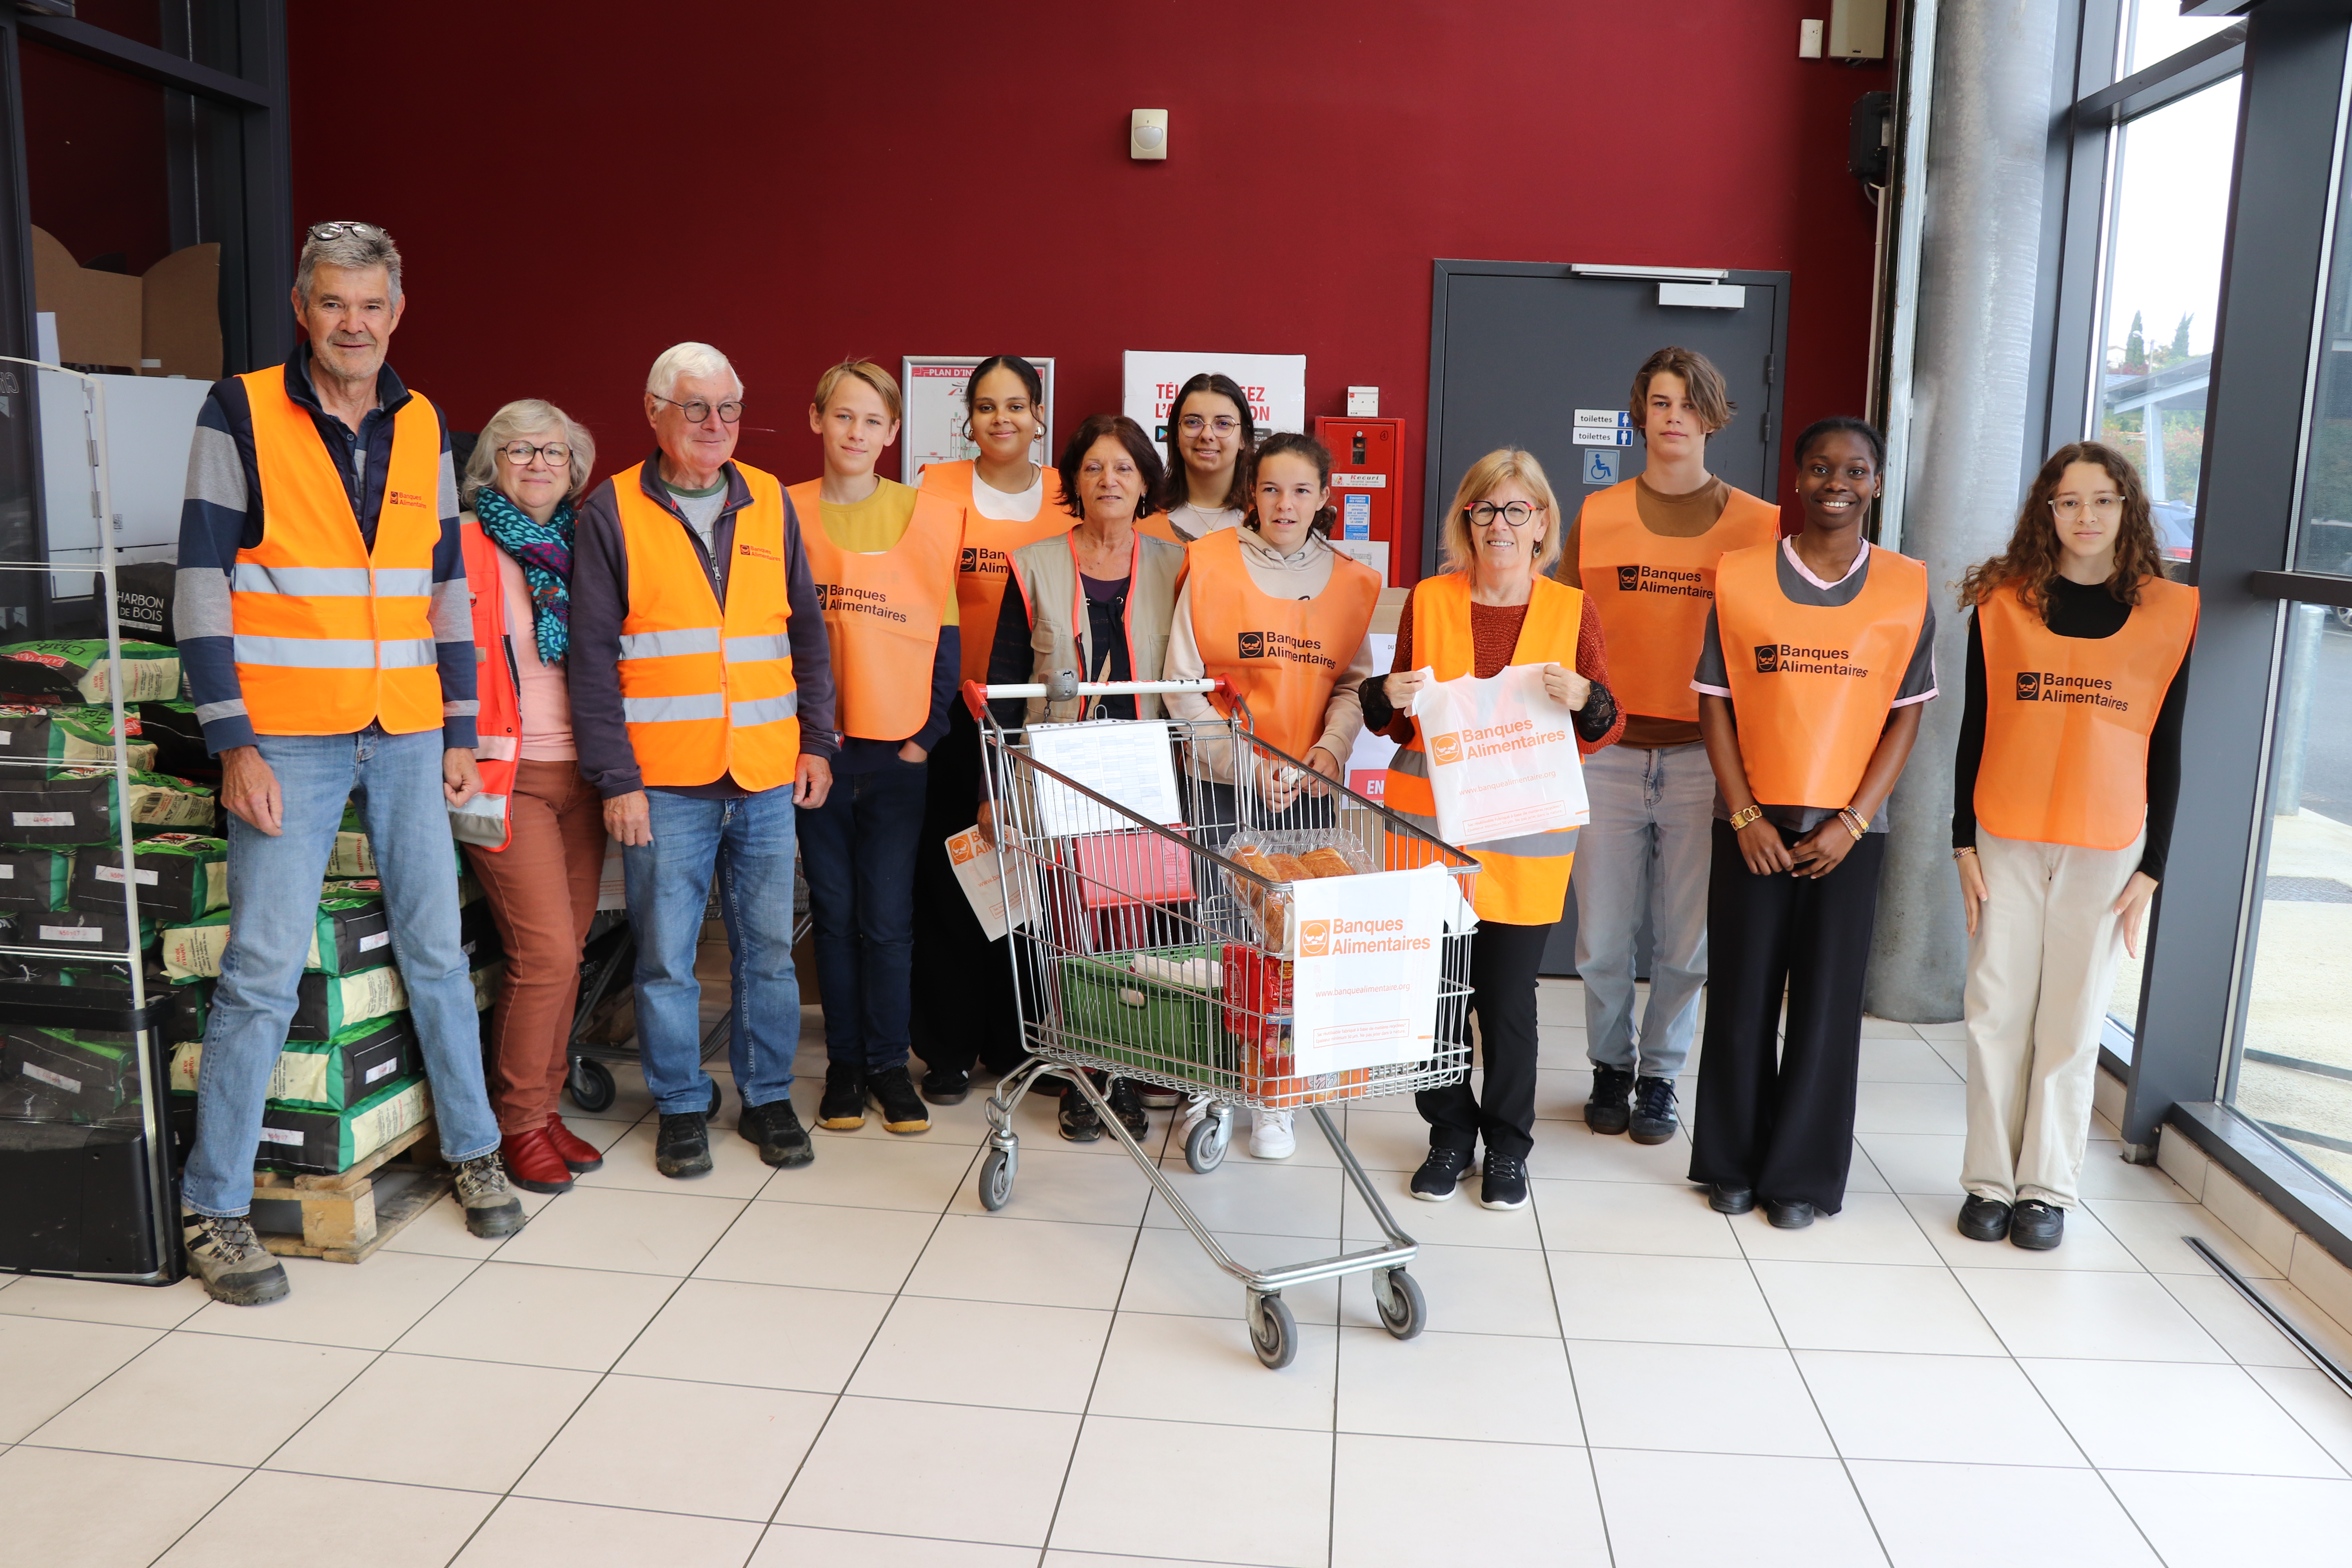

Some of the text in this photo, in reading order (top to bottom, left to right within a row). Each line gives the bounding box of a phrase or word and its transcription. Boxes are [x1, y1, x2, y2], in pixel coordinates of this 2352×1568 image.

[1581, 415, 1612, 423] toilettes
[1579, 432, 1611, 441] toilettes
[399, 492, 421, 501] Banques
[399, 500, 426, 509] Alimentaires
[750, 545, 772, 555] Banques
[751, 551, 781, 562] Alimentaires
[1641, 566, 1701, 582] Banques
[830, 584, 886, 603] Banques
[1639, 581, 1713, 599] Alimentaire
[117, 591, 164, 609] HARBON
[120, 606, 162, 621] DE BOIS
[829, 599, 907, 623] Alimentaires
[1267, 632, 1321, 650] Banques
[1267, 644, 1336, 670] Alimentaires
[1780, 644, 1849, 660] Banques
[1780, 659, 1868, 678] Alimentaires
[2043, 672, 2112, 691] Banques
[2042, 688, 2129, 711] Alimentaires
[1462, 719, 1533, 742] Banques
[1467, 730, 1566, 760] Alimentaires
[1366, 780, 1385, 795] EN
[1459, 771, 1556, 795] www.banquealimentaire.org
[1333, 918, 1403, 935] Banques
[1332, 935, 1430, 955] Alimentaires
[1315, 984, 1410, 997] www.banquealimentaire.org
